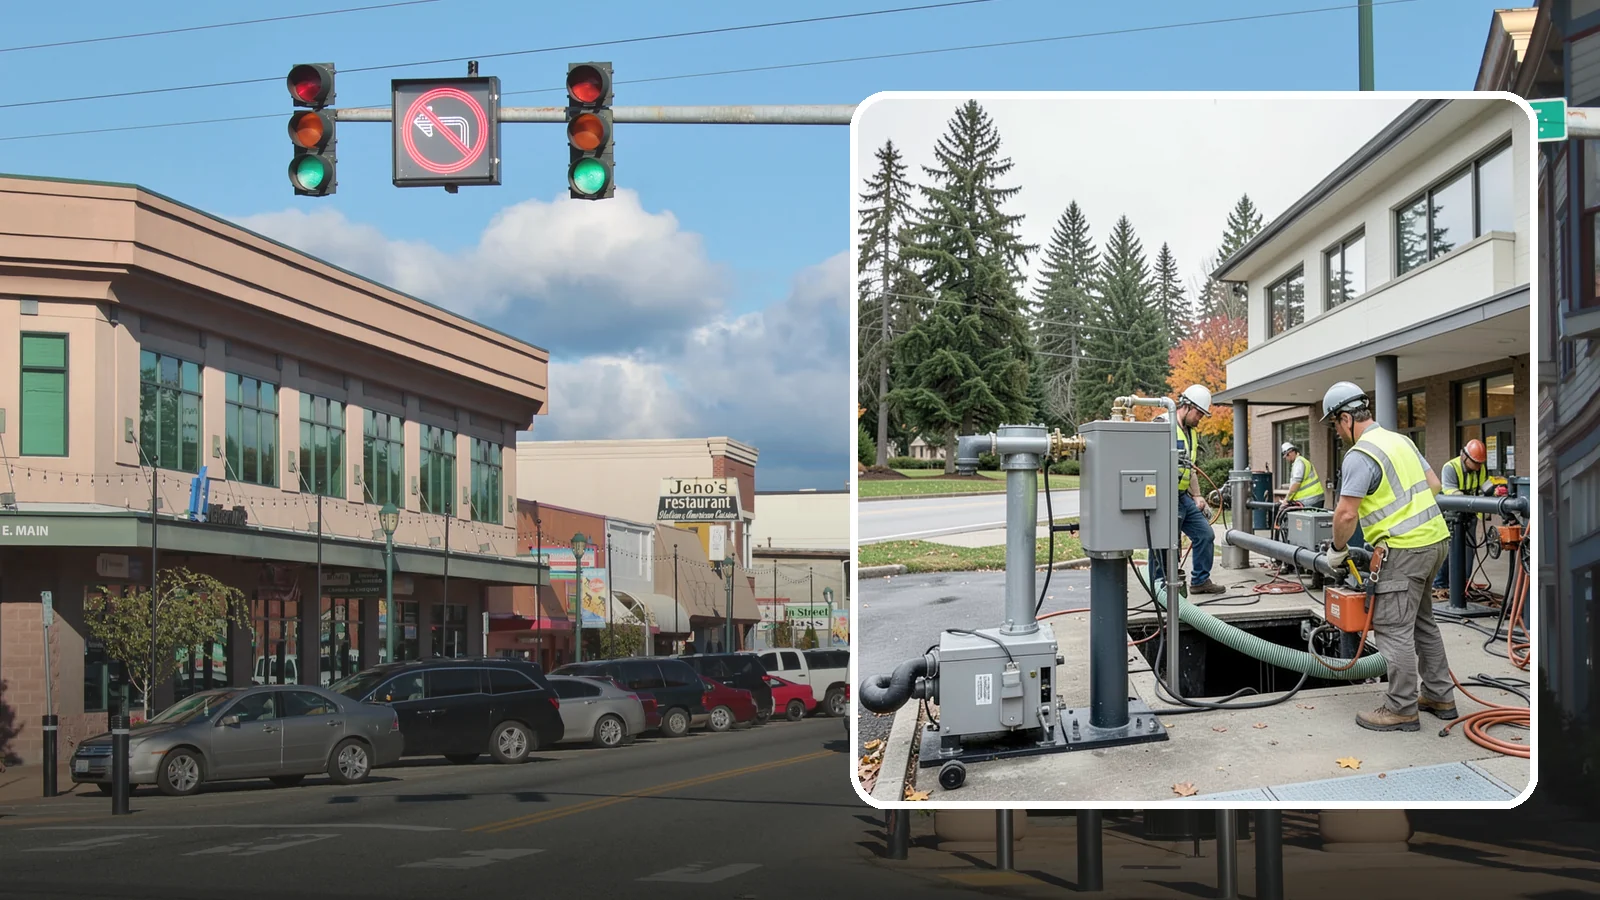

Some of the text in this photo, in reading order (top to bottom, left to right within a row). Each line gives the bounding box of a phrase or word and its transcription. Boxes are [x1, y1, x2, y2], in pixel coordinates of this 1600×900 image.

[669, 480, 727, 494] Jeno's
[665, 496, 731, 508] restaurant
[658, 510, 681, 519] Italian
[686, 509, 714, 519] American
[715, 509, 738, 519] Cuisine
[2, 525, 49, 536] E. MAIN
[798, 607, 828, 616] Street
